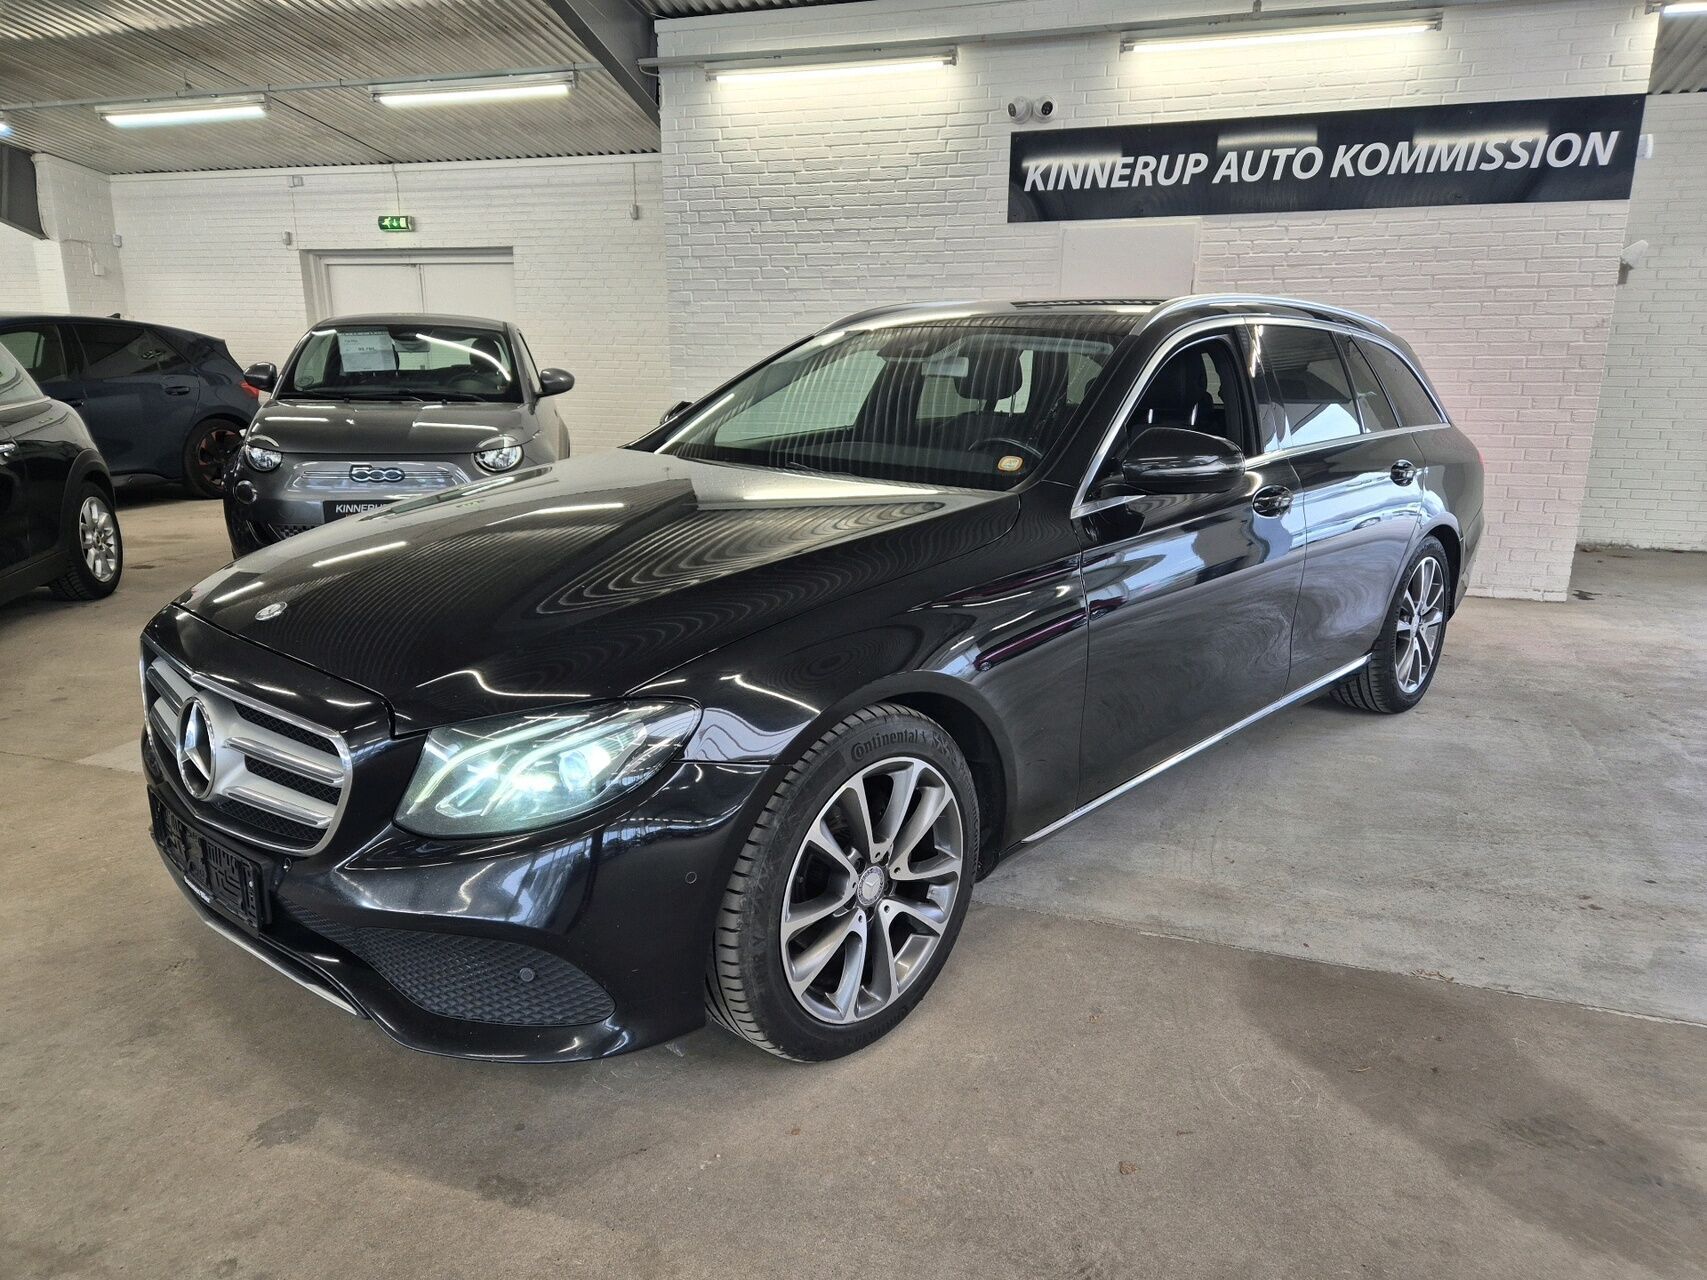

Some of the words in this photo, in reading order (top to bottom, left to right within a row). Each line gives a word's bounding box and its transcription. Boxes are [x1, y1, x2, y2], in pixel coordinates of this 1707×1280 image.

[1023, 152, 1208, 192] KINNERUP
[1211, 146, 1324, 185] AUTO
[1329, 130, 1620, 179] KOMMISSION
[351, 466, 403, 482] 500
[850, 728, 919, 761] Continental
